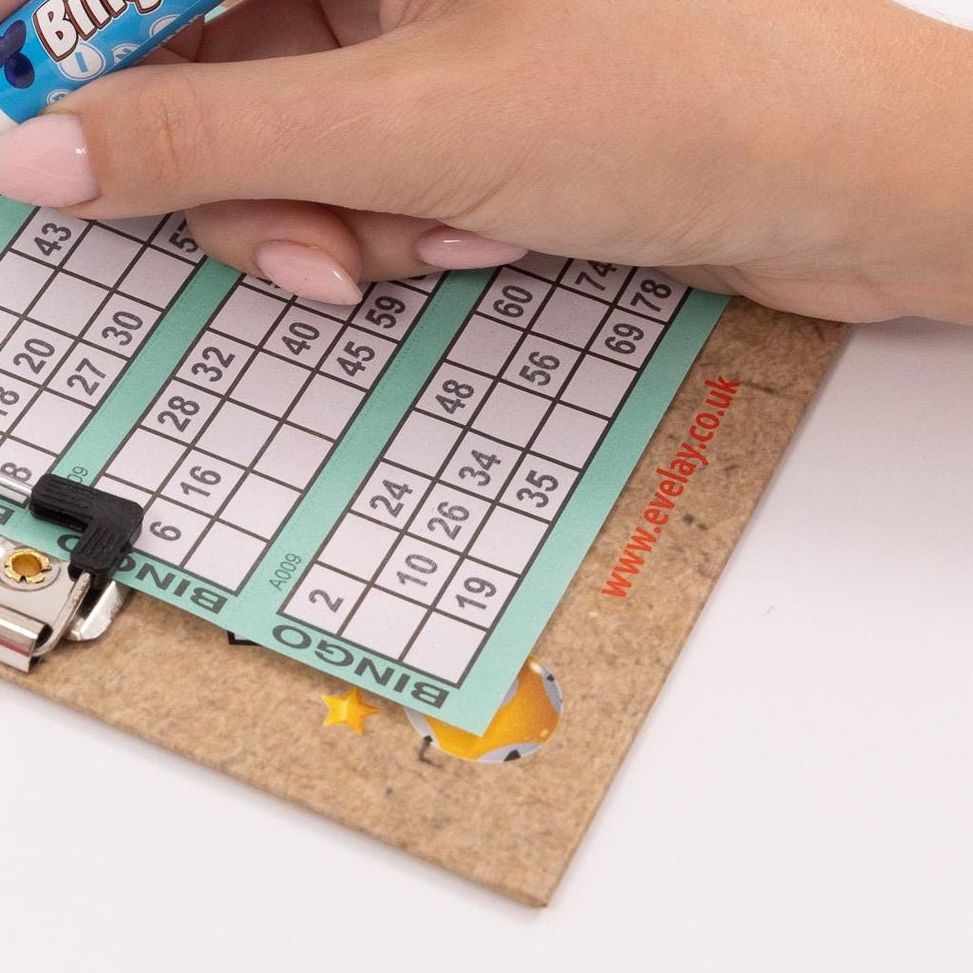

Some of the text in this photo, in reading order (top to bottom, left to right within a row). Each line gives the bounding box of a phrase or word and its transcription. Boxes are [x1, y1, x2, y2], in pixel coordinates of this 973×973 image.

[34, 223, 71, 256] 43
[0, 462, 32, 483] 8
[67, 358, 106, 396] 27
[102, 312, 143, 345] 30
[13, 339, 55, 374] 20
[158, 347, 235, 432] 28 32
[337, 296, 405, 376] 45 59
[150, 322, 319, 541] 6 16 40
[309, 285, 532, 612] 2 24 48 60
[397, 260, 617, 586] 10 26 34 56 74
[456, 279, 672, 609] 19 35 69 78
[601, 374, 741, 599] www.evelay.co.uk
[268, 553, 303, 592] A009
[271, 624, 450, 710] BINGO
